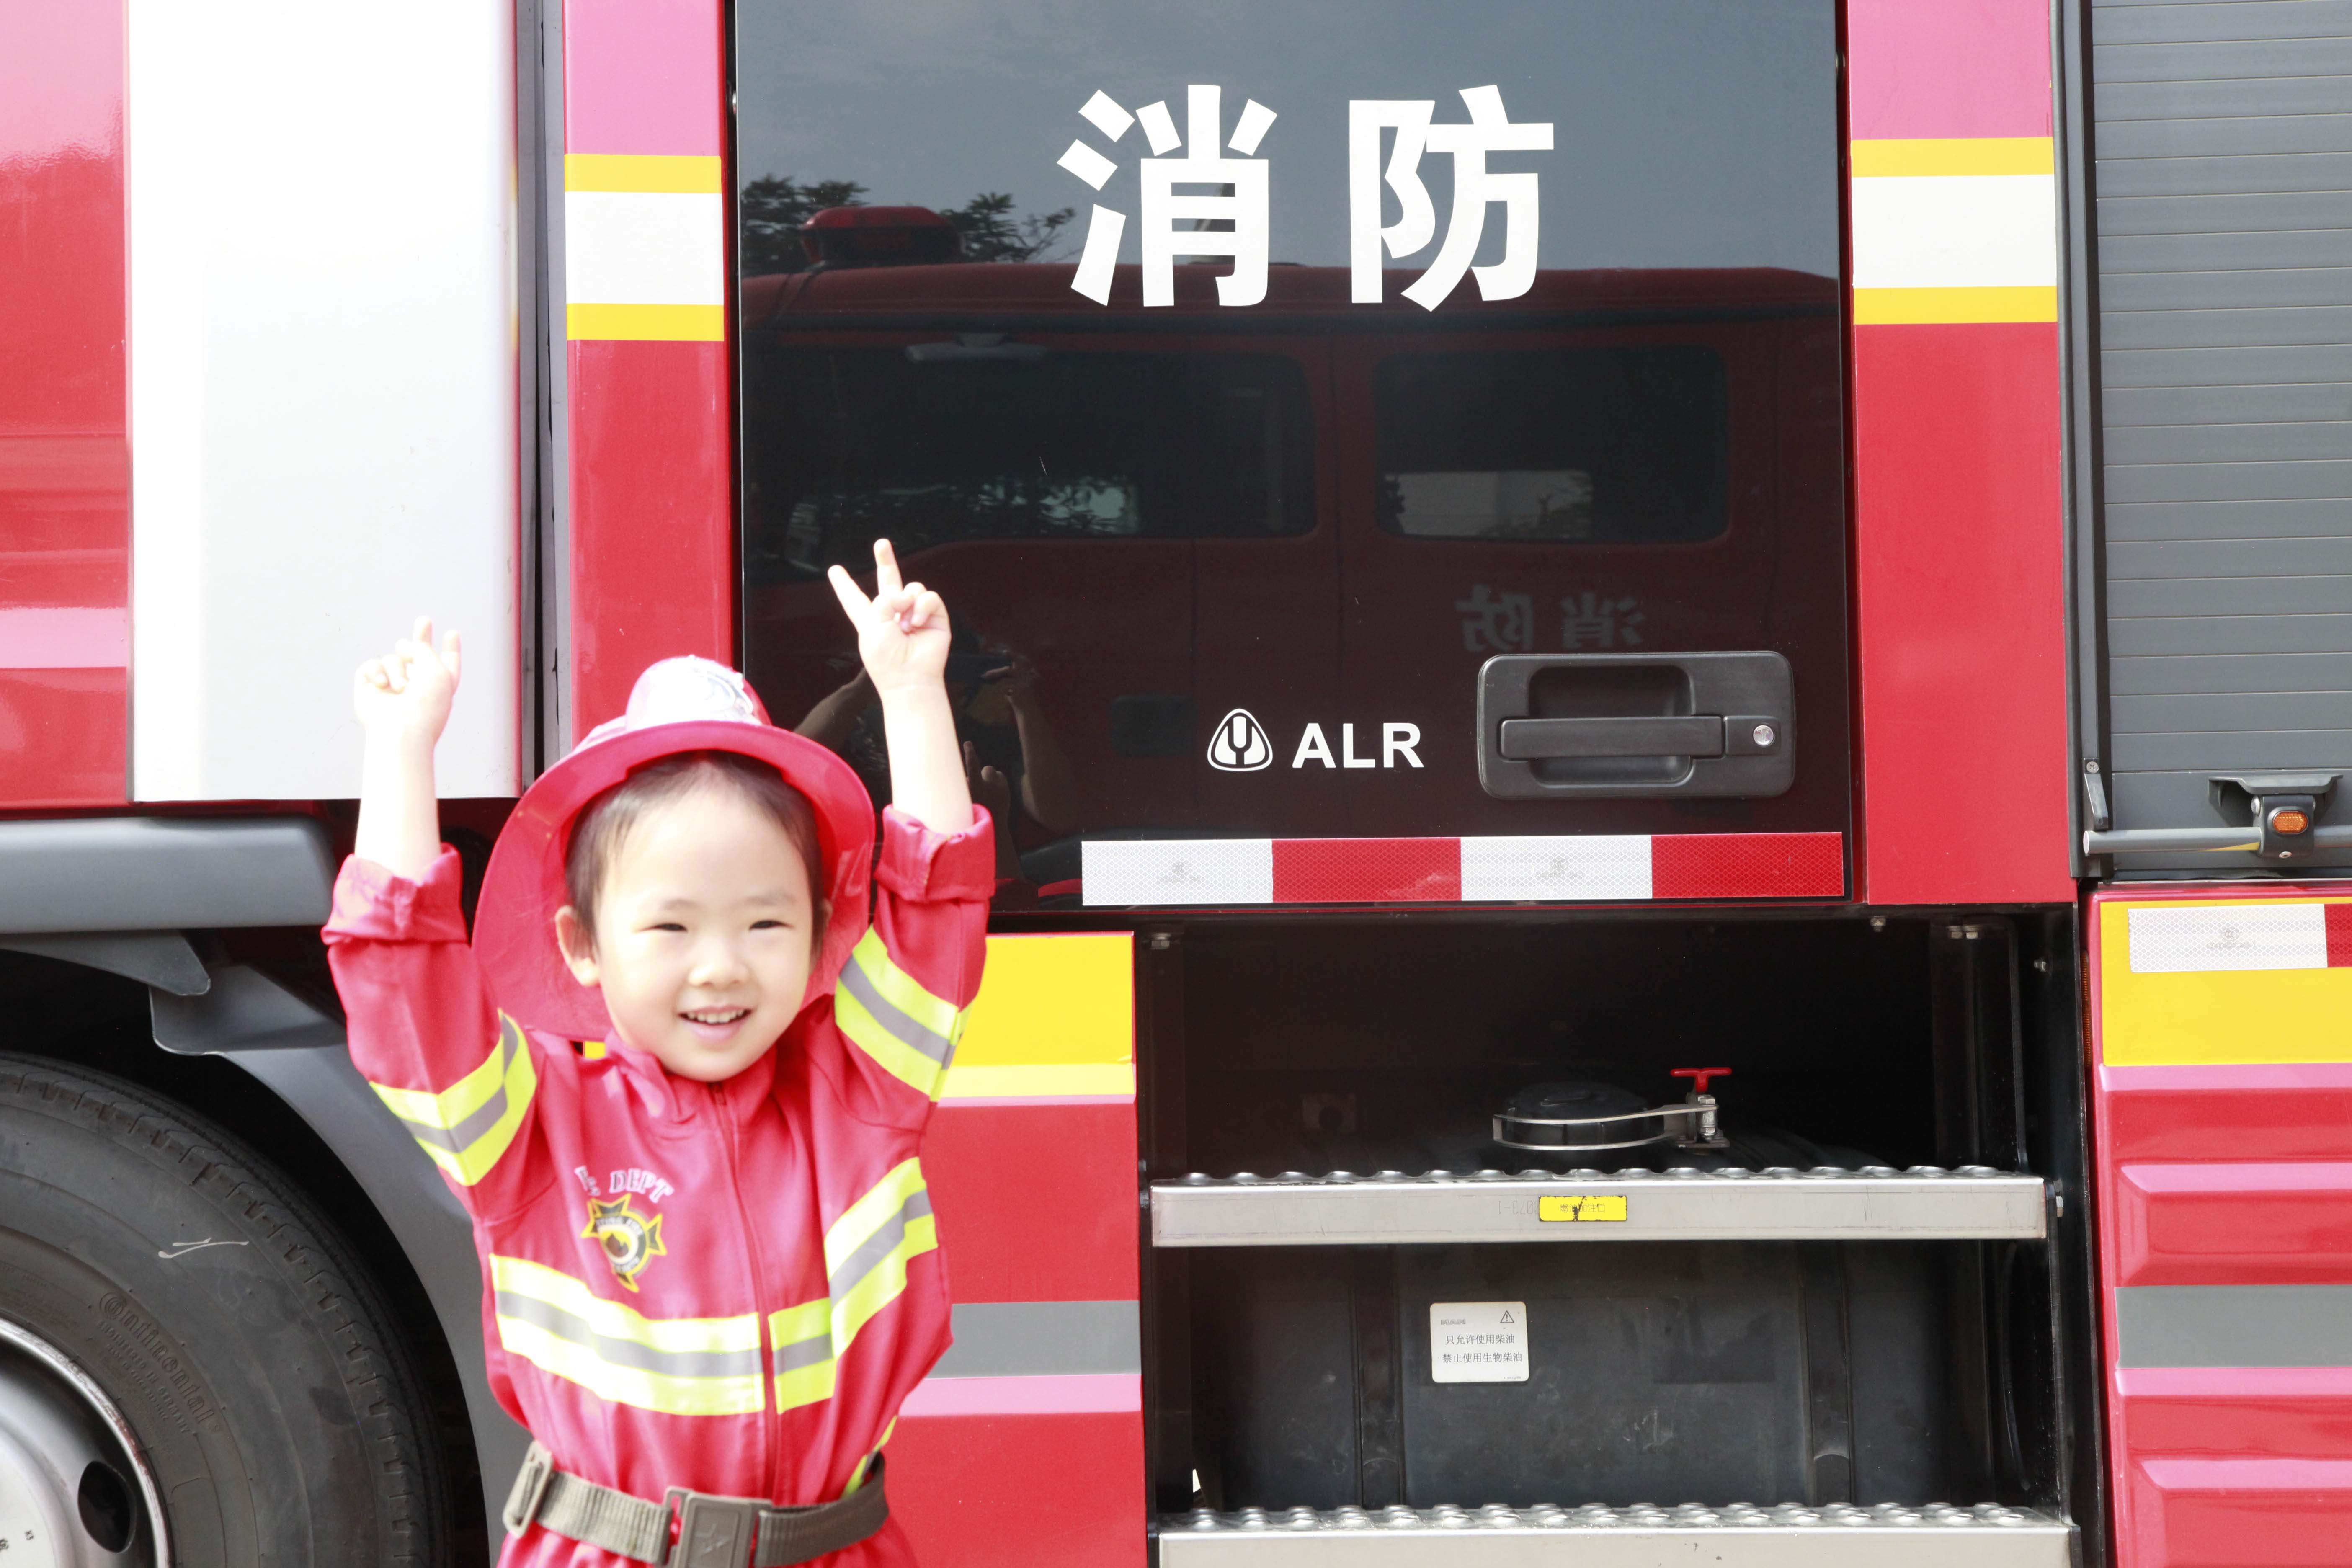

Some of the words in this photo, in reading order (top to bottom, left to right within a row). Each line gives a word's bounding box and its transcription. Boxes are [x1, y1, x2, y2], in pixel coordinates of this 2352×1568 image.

[1057, 85, 1553, 311] 消防
[1292, 723, 1424, 768] ALR
[609, 1168, 675, 1203] DEPT
[1445, 1334, 1515, 1345] 只允许使用柴油
[1442, 1352, 1522, 1363] 禁止使用生物柴油
